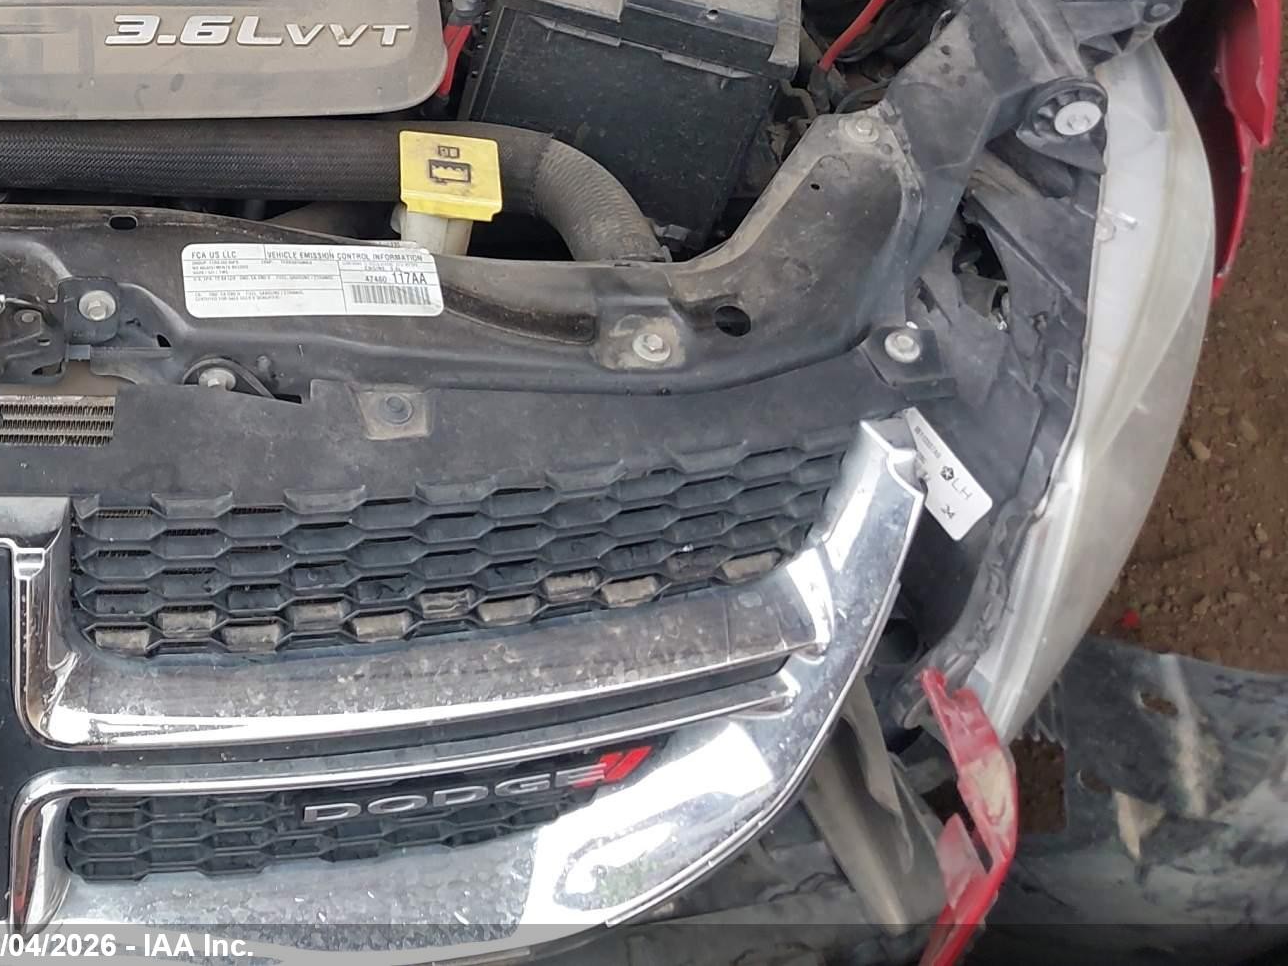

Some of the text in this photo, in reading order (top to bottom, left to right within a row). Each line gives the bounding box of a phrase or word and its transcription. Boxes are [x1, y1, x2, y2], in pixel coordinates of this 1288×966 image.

[104, 15, 411, 46] 3.6L VVT
[191, 250, 237, 259] FCA US LLC
[267, 251, 423, 262] VEHICLE EMISSION CONTROL INFORMATION
[393, 272, 428, 284] 117AA
[951, 477, 973, 500] LH
[304, 763, 607, 823] DODGE
